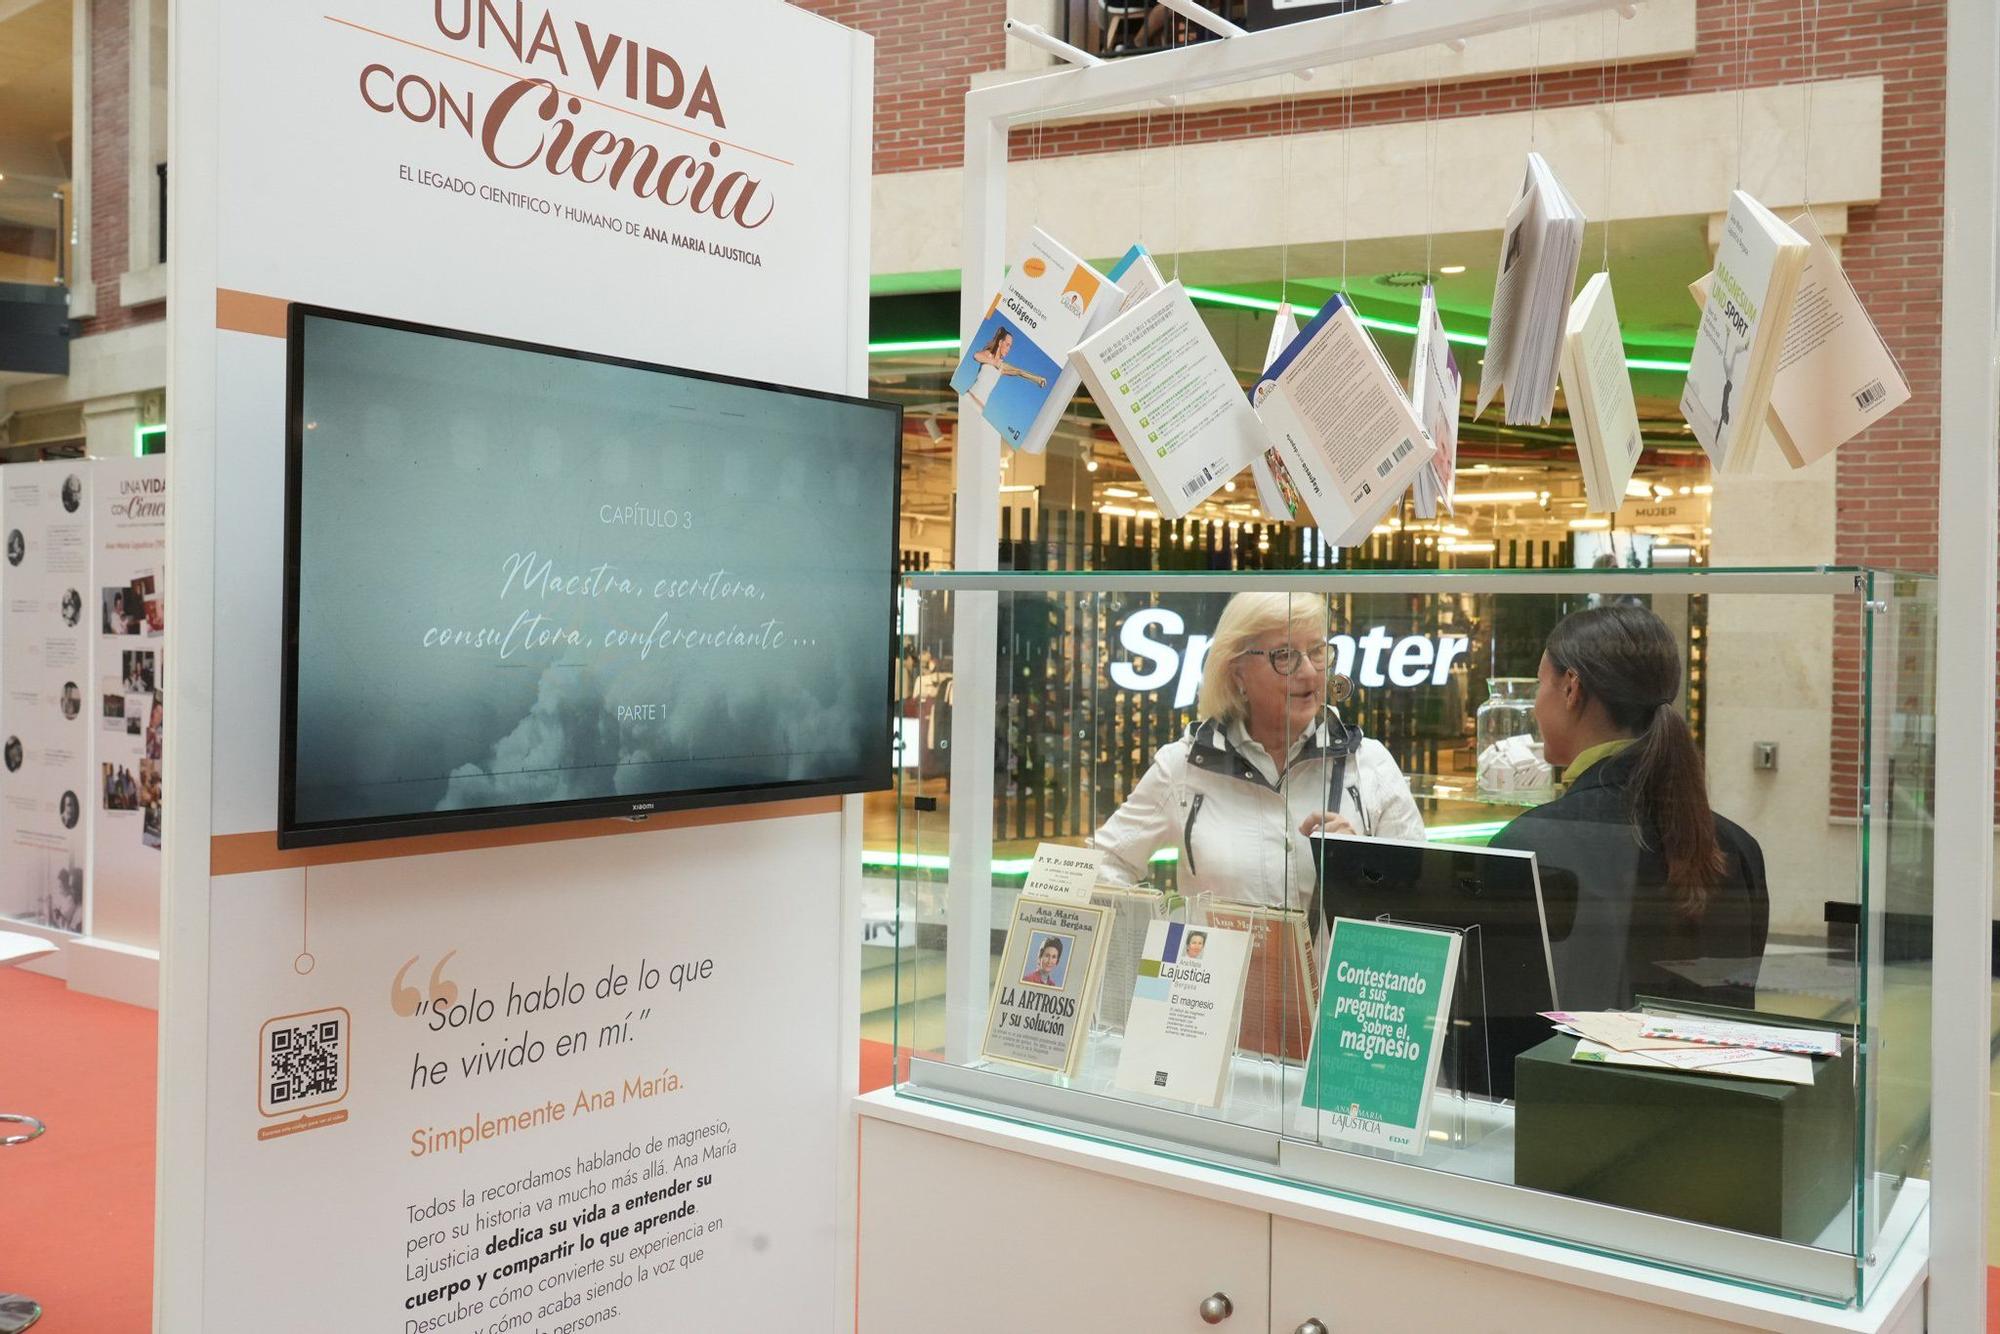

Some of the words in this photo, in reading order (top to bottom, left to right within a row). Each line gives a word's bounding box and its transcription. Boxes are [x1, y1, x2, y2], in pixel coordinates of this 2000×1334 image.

[434, 0, 568, 76] UNA
[574, 20, 727, 129] VIDA
[359, 63, 474, 139] CON
[481, 77, 775, 229] Ciencia
[399, 164, 414, 182] EL
[418, 169, 476, 197] LEGADO
[479, 185, 550, 215] CIENTIFICO
[553, 203, 562, 217] Y
[565, 207, 623, 232] HUMANO
[626, 221, 641, 237] DE
[643, 226, 669, 245] ANA
[671, 233, 706, 253] MARIA
[709, 242, 762, 267] LAJUSTICIA
[1013, 289, 1033, 309] respuesta
[1717, 261, 1757, 322] MAGNESIUM
[1007, 298, 1037, 329] Colágeno
[1712, 282, 1727, 309] UND
[1724, 300, 1749, 338] SPORT
[120, 479, 141, 494] UNA
[600, 503, 677, 529] CAPÍTULO
[682, 511, 693, 529] 3
[1636, 507, 1677, 518] MUJER
[500, 551, 643, 601] Maestra,
[653, 568, 766, 601] escritora,
[423, 609, 593, 659] consultora,
[1110, 608, 1469, 710] Spnter
[617, 704, 656, 721] PARTE
[661, 703, 667, 721] 1
[1030, 882, 1070, 893] REPONGAN
[1020, 913, 1057, 926] Lajusticia
[1060, 919, 1092, 932] Bergasa
[1036, 907, 1052, 917] Ana
[1054, 910, 1079, 920] María
[507, 969, 585, 1017] hablo
[595, 964, 629, 1001] de
[638, 958, 660, 991] lo
[669, 957, 714, 994] que
[1160, 964, 1211, 984] Lajusticia
[1337, 961, 1426, 995] Contestando
[1000, 987, 1015, 1006] LA
[1018, 990, 1075, 1018] ARTROSIS
[1171, 995, 1179, 1004] El
[1180, 996, 1214, 1011] magnesio
[1334, 996, 1406, 1023] preguntas
[1359, 986, 1366, 998] a
[1369, 988, 1387, 1002] sus
[999, 1012, 1008, 1028] y
[1009, 1013, 1022, 1027] su
[1023, 1013, 1065, 1036] solución
[1362, 1019, 1393, 1037] sobre
[1396, 1024, 1408, 1039] el
[410, 1053, 449, 1090] he
[461, 1030, 544, 1079] vivido
[556, 1030, 587, 1057] en
[1340, 1030, 1420, 1060] magnesio
[410, 1099, 565, 1157] Simplemente
[573, 1088, 615, 1116] Ana
[622, 1068, 683, 1104] María.
[1332, 1114, 1381, 1134] LAJUSTICIA
[1335, 1105, 1351, 1114] ANA
[407, 1196, 456, 1224] Todos
[461, 1189, 475, 1209] la
[481, 1164, 572, 1204] recordamos
[577, 1140, 641, 1175] hablando
[645, 1136, 663, 1156] de
[667, 1119, 732, 1150] magnesio,
[406, 1229, 447, 1258] pero
[451, 1222, 470, 1240] su
[476, 1202, 531, 1232] historia
[536, 1198, 553, 1214] va
[558, 1178, 607, 1208] mucho
[611, 1168, 638, 1191] más
[642, 1160, 668, 1185] allá.
[673, 1153, 699, 1172] Ana
[703, 1139, 737, 1165] María
[406, 1245, 480, 1282] Lajusticia
[485, 1224, 544, 1257] dedica
[548, 1219, 568, 1236] su
[573, 1204, 607, 1229] vida
[611, 1203, 621, 1215] a
[625, 1178, 692, 1212] entender
[697, 1172, 713, 1188] su
[405, 1278, 471, 1310] cuerpo
[477, 1272, 488, 1291] y
[493, 1241, 575, 1280] compartir
[580, 1234, 595, 1251] lo
[600, 1222, 629, 1248] que
[405, 1301, 484, 1334] Descubre
[489, 1284, 533, 1309] cómo
[538, 1260, 604, 1292] convierte
[609, 1252, 625, 1268] su
[629, 1223, 703, 1262] experiencia
[707, 1216, 723, 1233] en
[489, 1314, 533, 1334] cómo
[538, 1292, 581, 1319] acaba
[586, 1272, 633, 1302] siendo
[637, 1265, 649, 1284] la
[653, 1258, 676, 1276] voz
[680, 1249, 704, 1274] que
[554, 1305, 621, 1334] personas.
